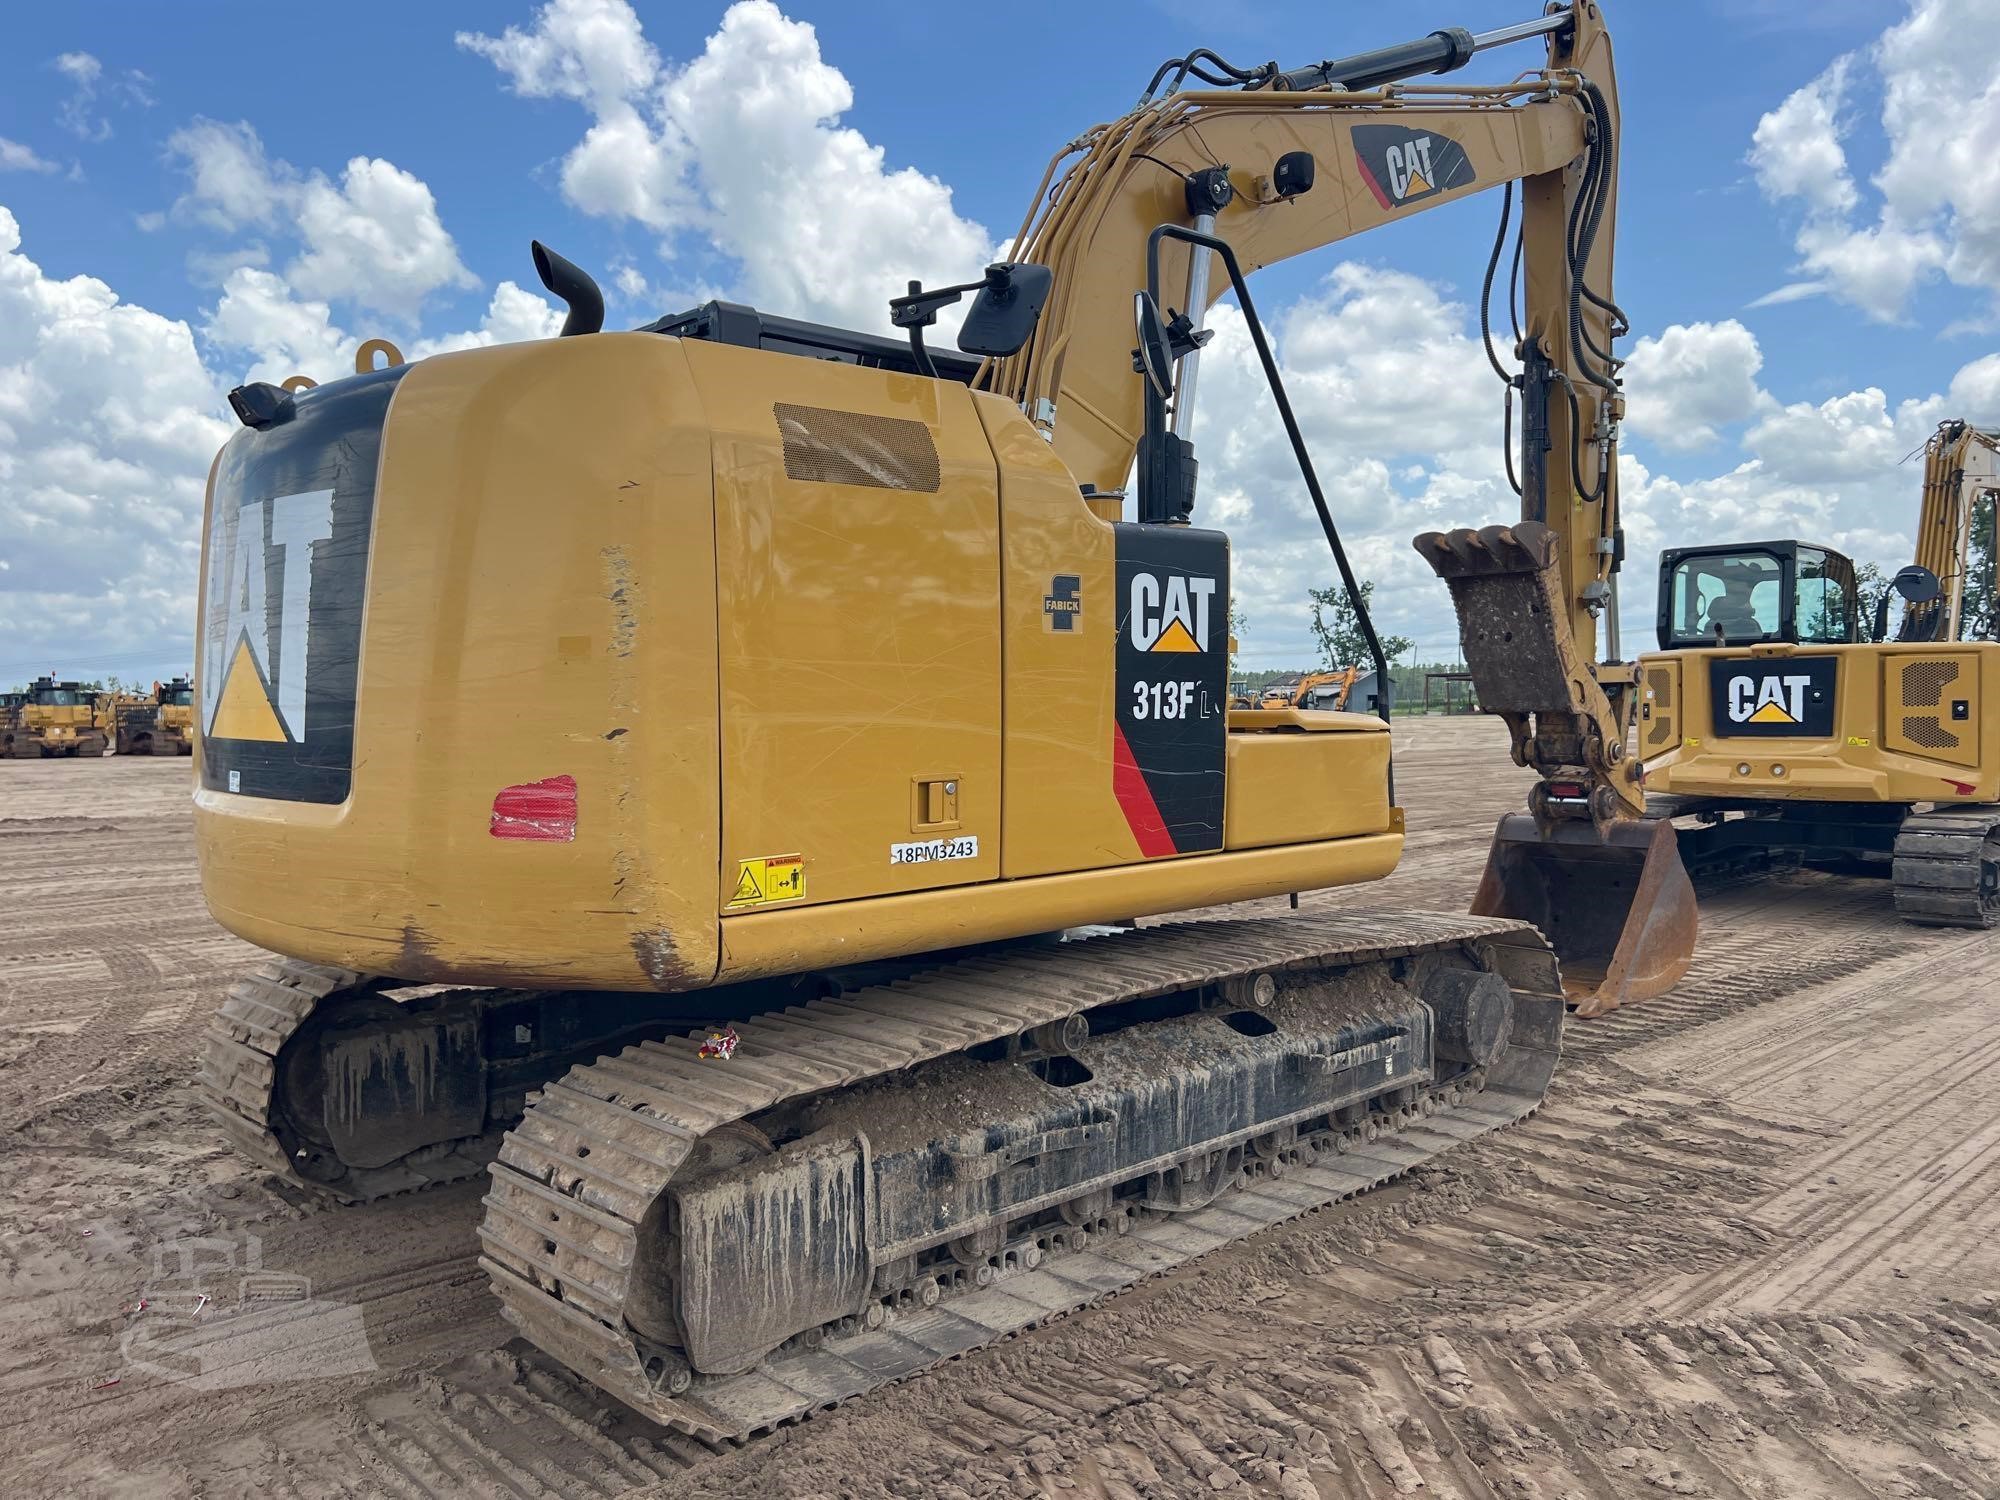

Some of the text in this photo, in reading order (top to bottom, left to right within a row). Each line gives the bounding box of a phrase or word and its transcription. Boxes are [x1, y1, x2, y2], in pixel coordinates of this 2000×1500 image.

[1386, 136, 1435, 200] CAT
[1045, 600, 1079, 611] FABICK
[1131, 572, 1215, 653] CAT
[1728, 675, 1811, 723] CAT
[896, 841, 974, 863] 18PM3243
